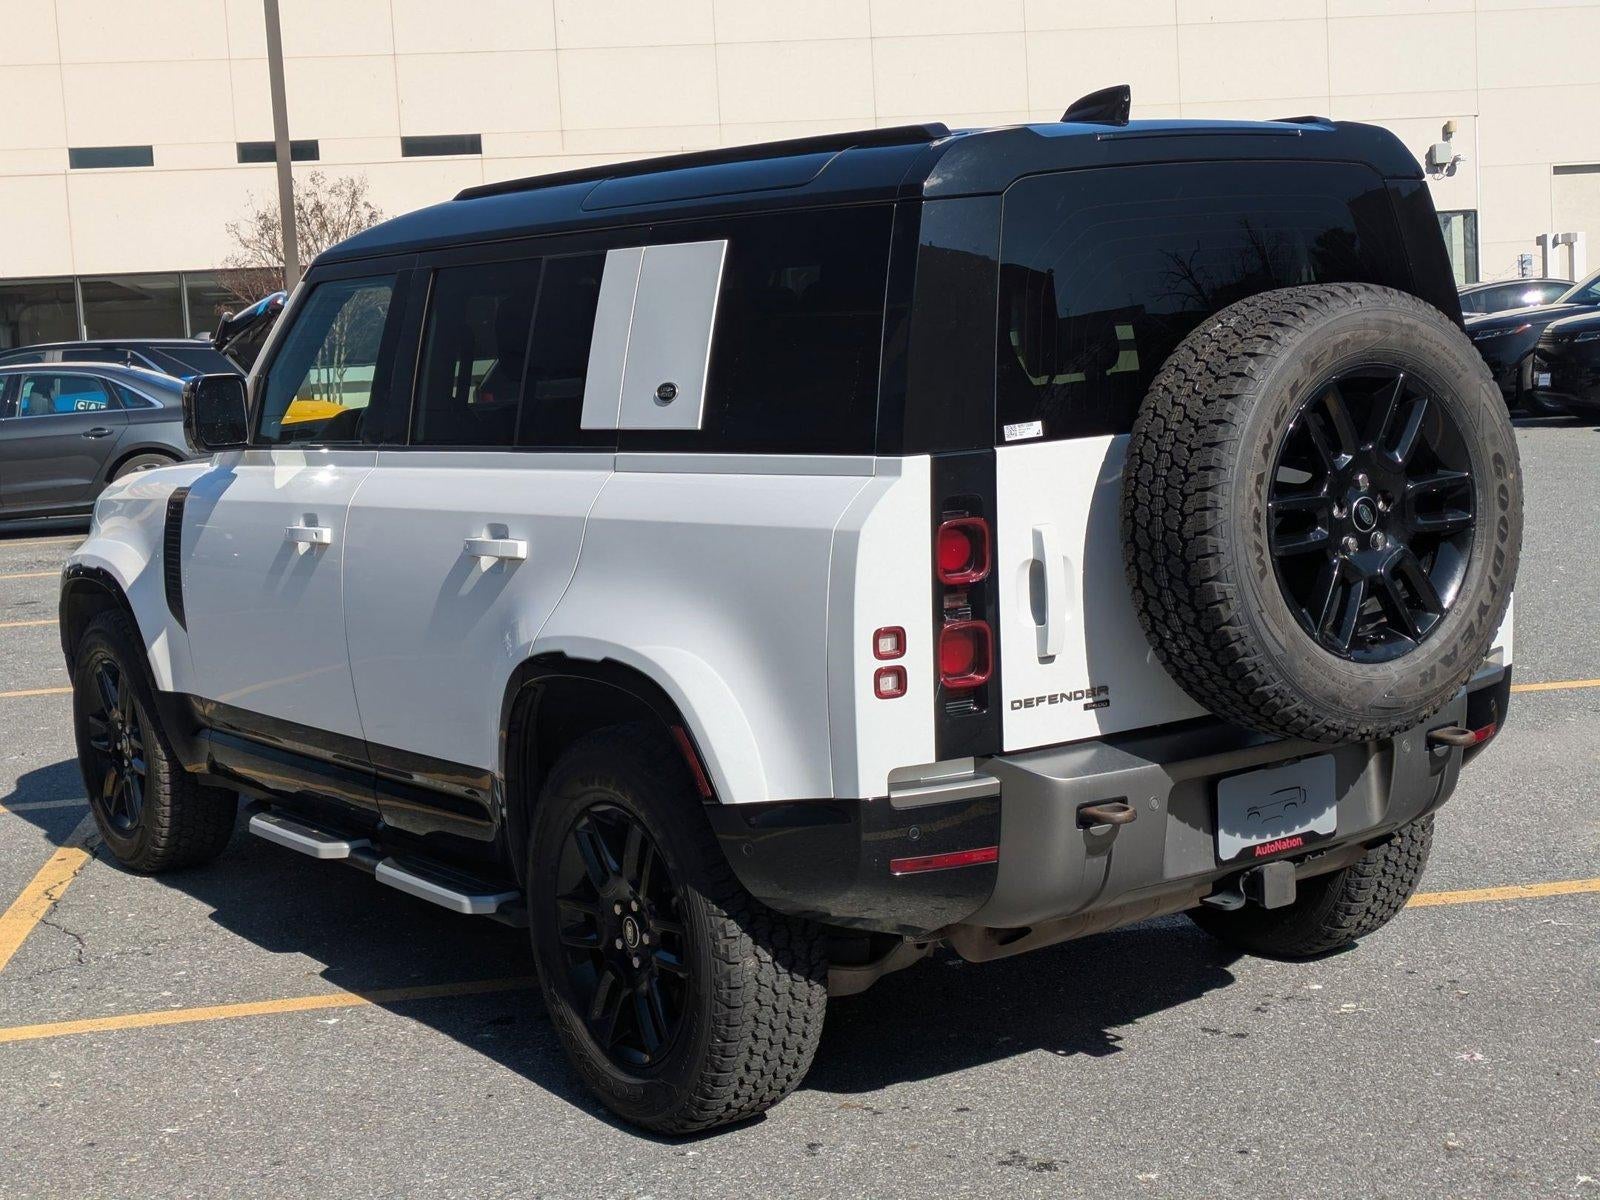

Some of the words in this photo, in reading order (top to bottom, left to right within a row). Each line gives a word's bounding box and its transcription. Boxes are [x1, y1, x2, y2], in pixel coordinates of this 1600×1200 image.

[1418, 452, 1510, 688] GOODYEAR
[1010, 685, 1109, 710] DEFENDER
[1254, 836, 1303, 857] AutoNation
